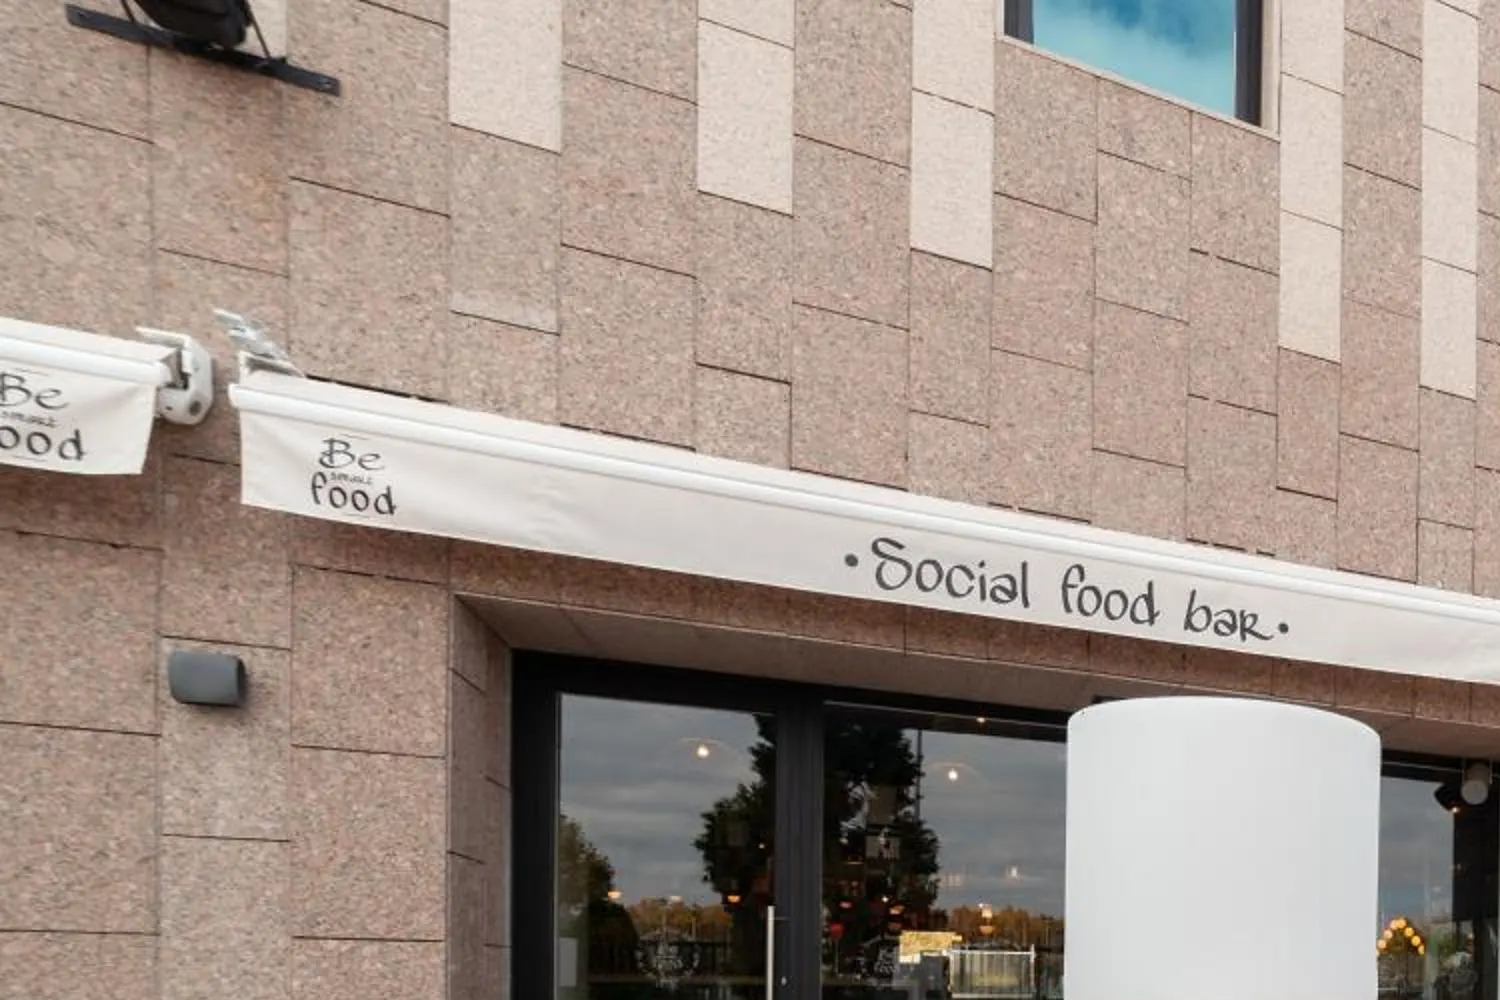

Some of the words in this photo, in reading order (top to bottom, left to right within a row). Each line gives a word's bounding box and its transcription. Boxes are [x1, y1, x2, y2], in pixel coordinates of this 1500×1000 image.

[0, 372, 70, 411] Be
[0, 425, 87, 462] ood
[318, 438, 386, 471] Be
[311, 471, 397, 516] food
[871, 537, 1030, 609] Social
[1061, 564, 1161, 627] food
